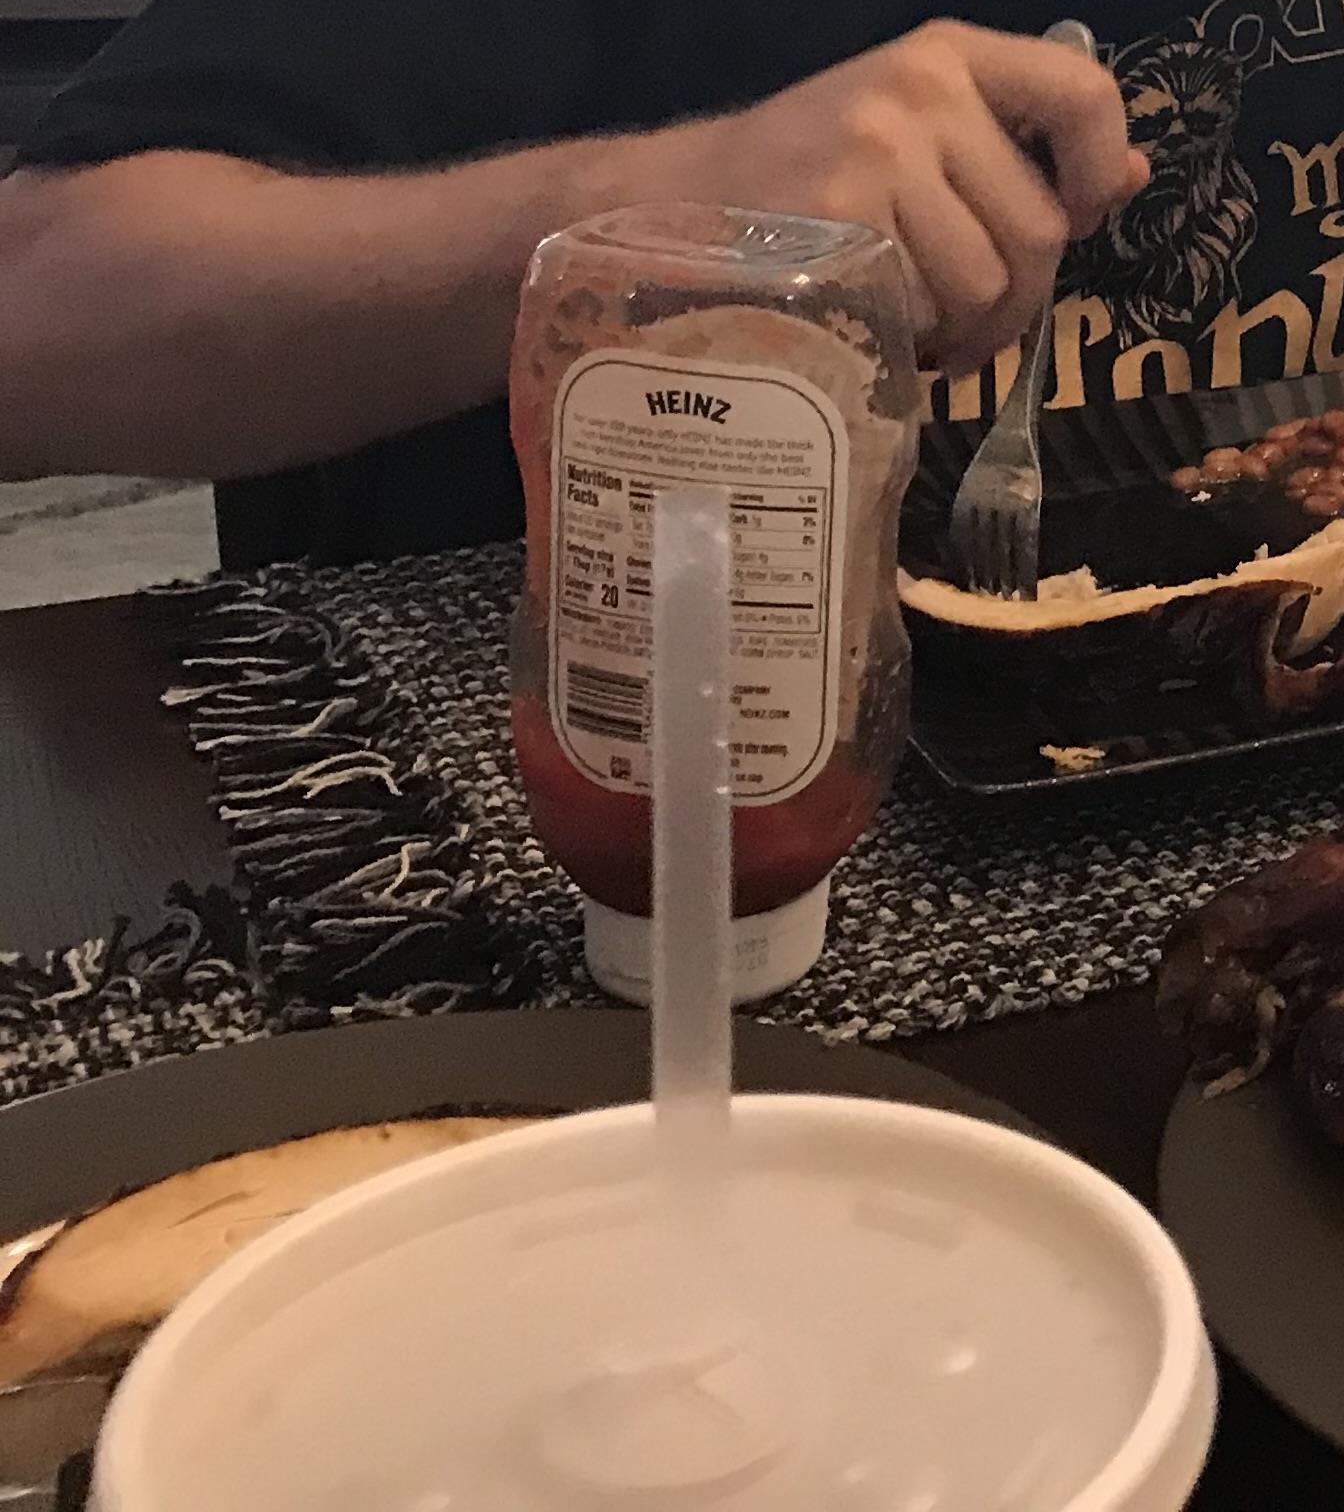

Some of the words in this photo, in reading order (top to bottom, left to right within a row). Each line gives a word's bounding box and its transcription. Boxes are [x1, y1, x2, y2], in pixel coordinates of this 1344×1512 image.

[645, 390, 732, 425] HEINZ
[567, 463, 622, 492] Nutrition
[567, 484, 599, 507] Facts
[601, 583, 619, 609] 20
